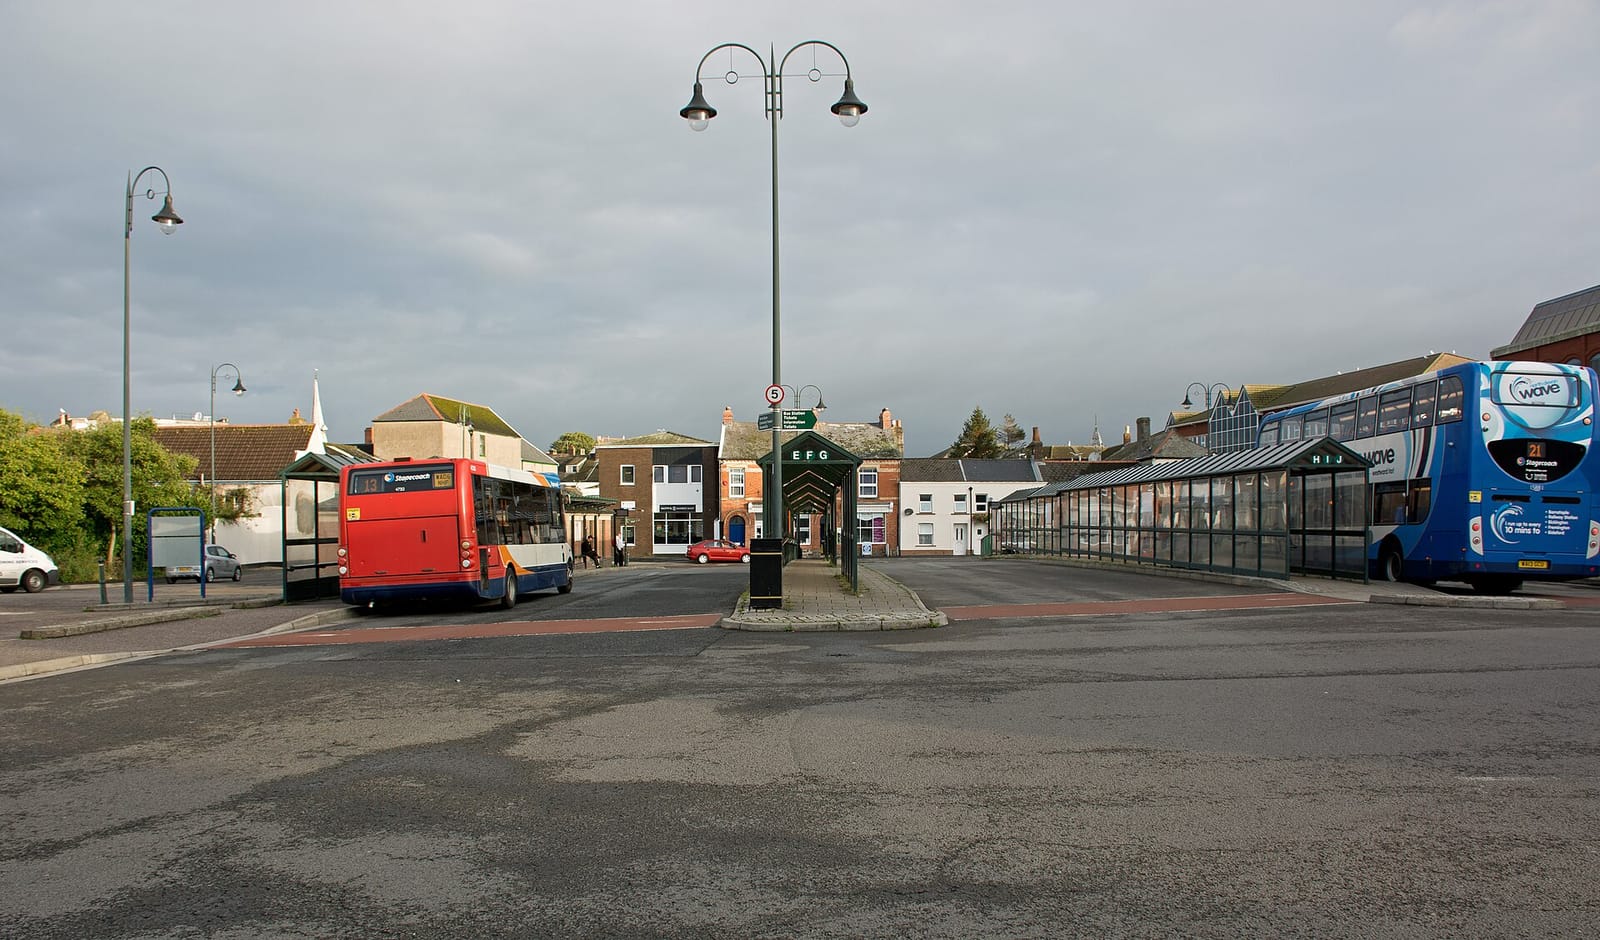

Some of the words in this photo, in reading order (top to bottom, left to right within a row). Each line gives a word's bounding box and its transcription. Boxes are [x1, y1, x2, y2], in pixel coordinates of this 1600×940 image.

[771, 389, 779, 399] 5
[1519, 383, 1560, 399] wave
[793, 450, 800, 460] E
[806, 450, 813, 460] F
[819, 450, 828, 460] G
[1529, 444, 1542, 457] 21
[1313, 455, 1320, 464] H
[1336, 455, 1342, 464] J
[1525, 459, 1558, 467] Stagecoach
[394, 473, 431, 482] Stagecoach
[1514, 526, 1530, 534] mins
